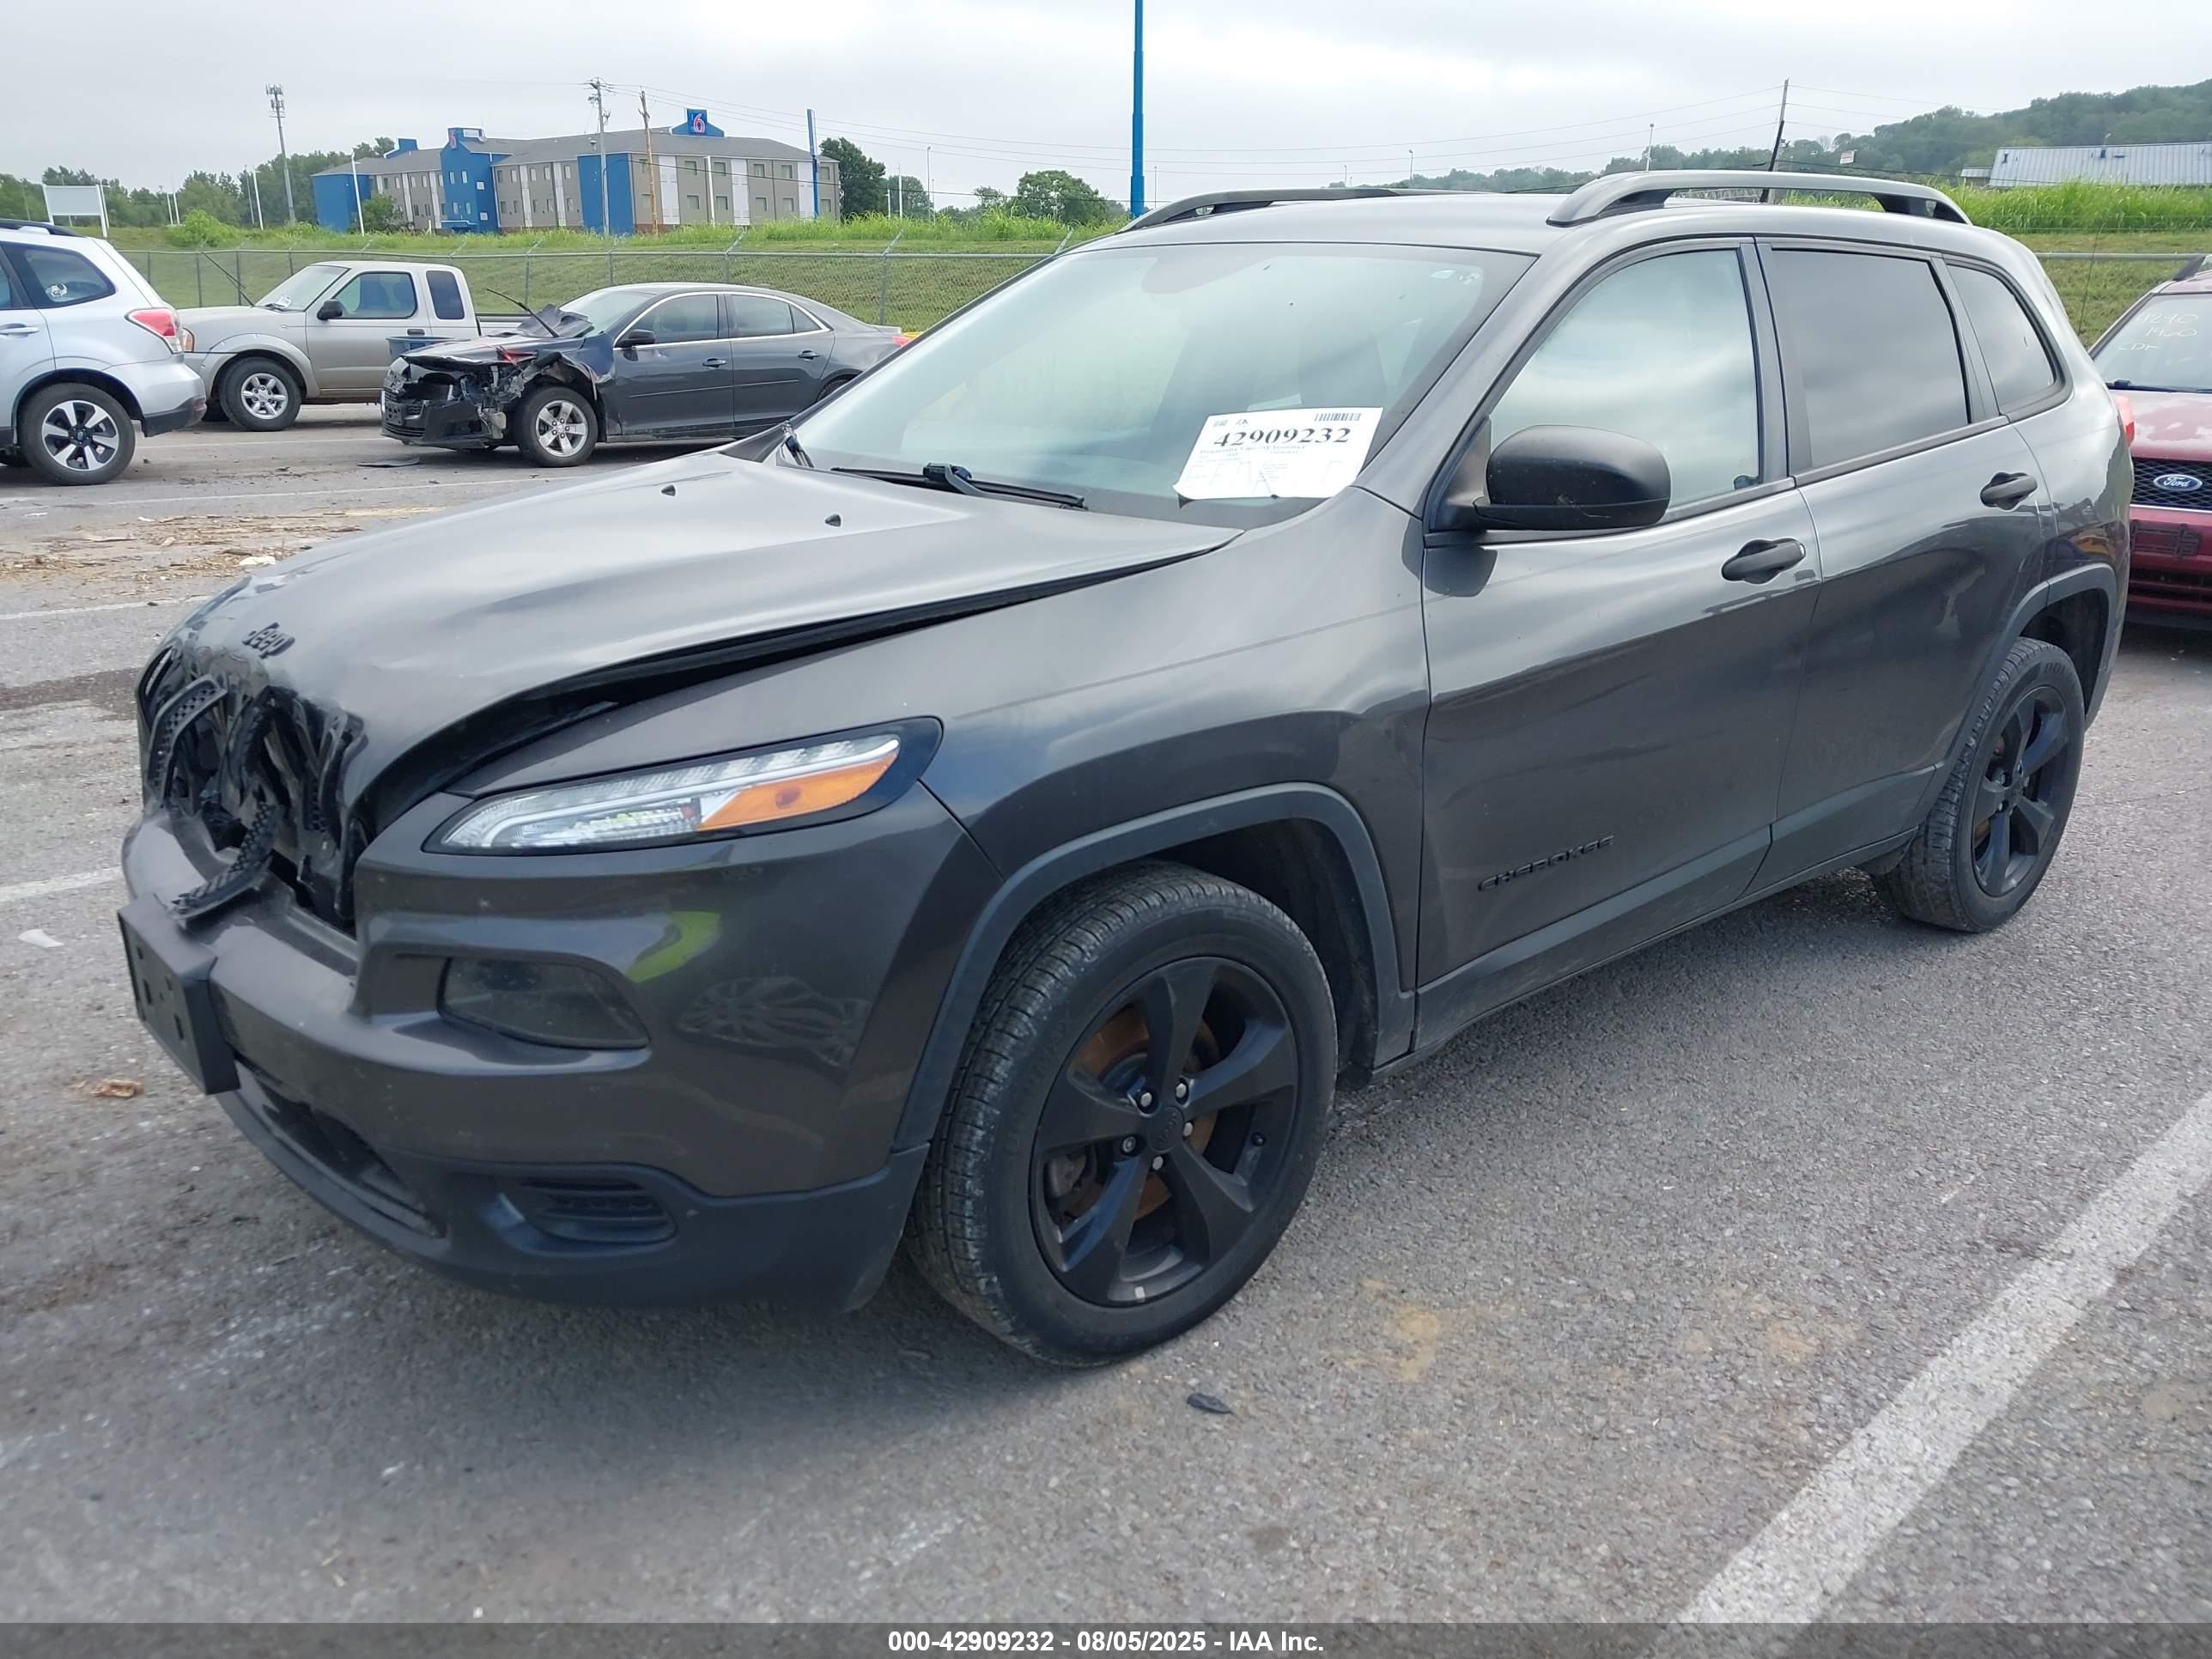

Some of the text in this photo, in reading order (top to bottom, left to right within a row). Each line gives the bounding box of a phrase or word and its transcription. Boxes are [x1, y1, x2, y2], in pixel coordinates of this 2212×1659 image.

[693, 112, 706, 133] 6
[1214, 428, 1351, 447] 42909232
[2164, 476, 2192, 487] Ford
